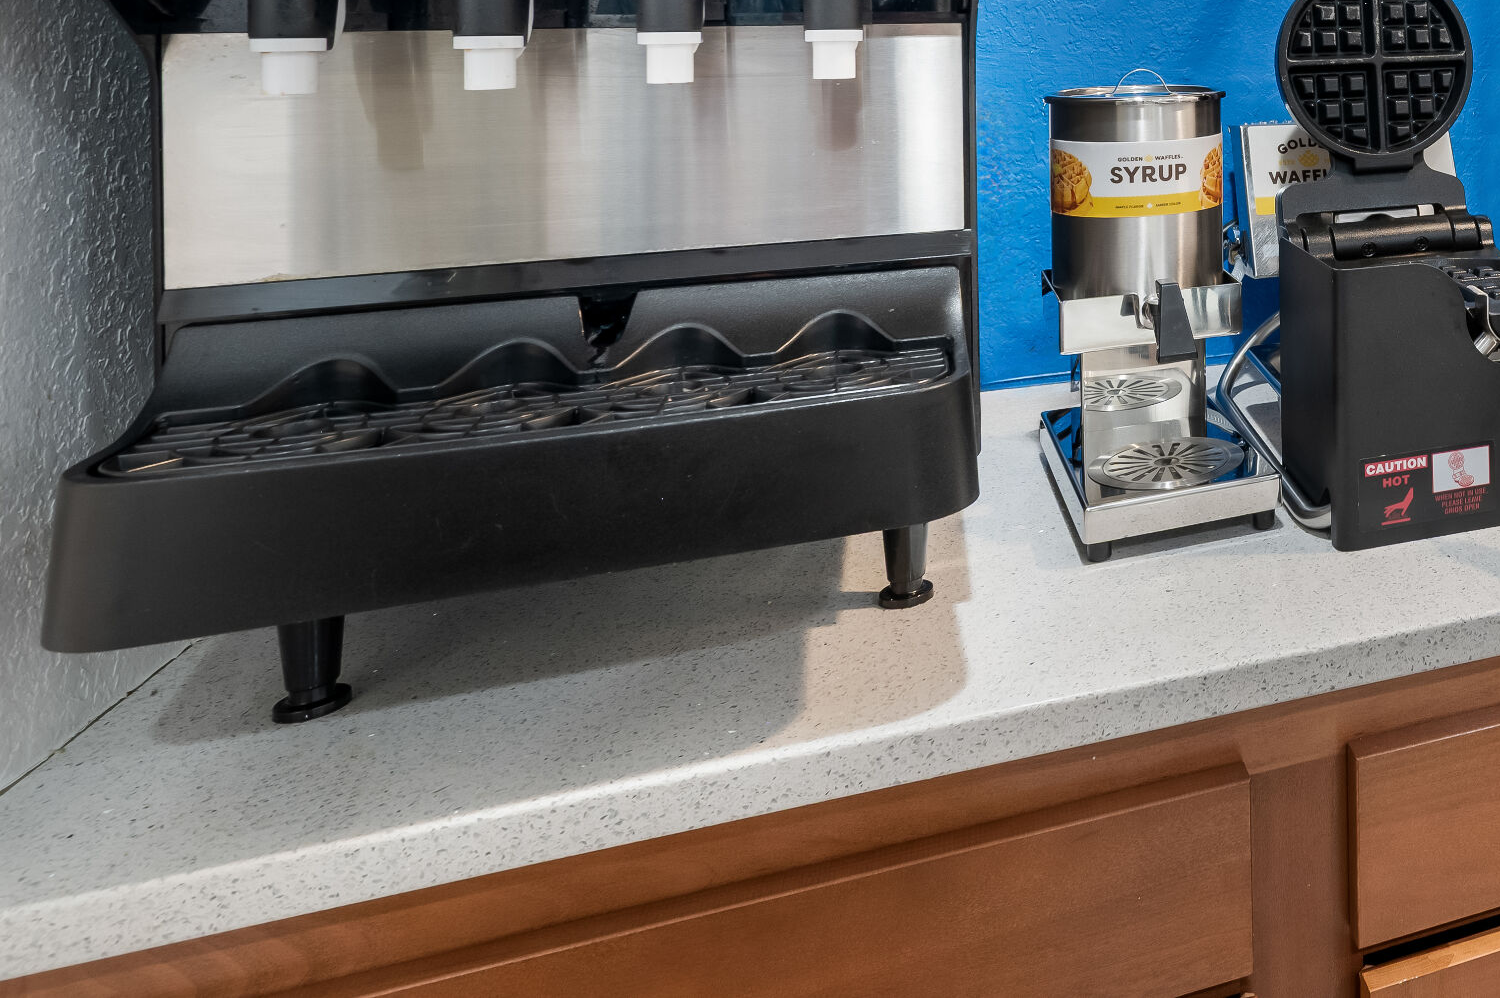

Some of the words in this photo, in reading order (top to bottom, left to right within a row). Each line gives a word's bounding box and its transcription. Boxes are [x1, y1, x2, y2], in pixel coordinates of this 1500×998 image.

[1277, 137, 1325, 154] GOLD
[1110, 163, 1187, 184] SYRUP
[1268, 168, 1327, 185] WAFF
[1366, 456, 1427, 476] CAUTION
[1382, 474, 1411, 489] HOT
[1434, 493, 1453, 502] WHEN
[1454, 491, 1465, 499] NOT
[1441, 499, 1464, 508] PLEASE
[1464, 495, 1483, 504] LEAVE
[1464, 502, 1480, 512] OPEN
